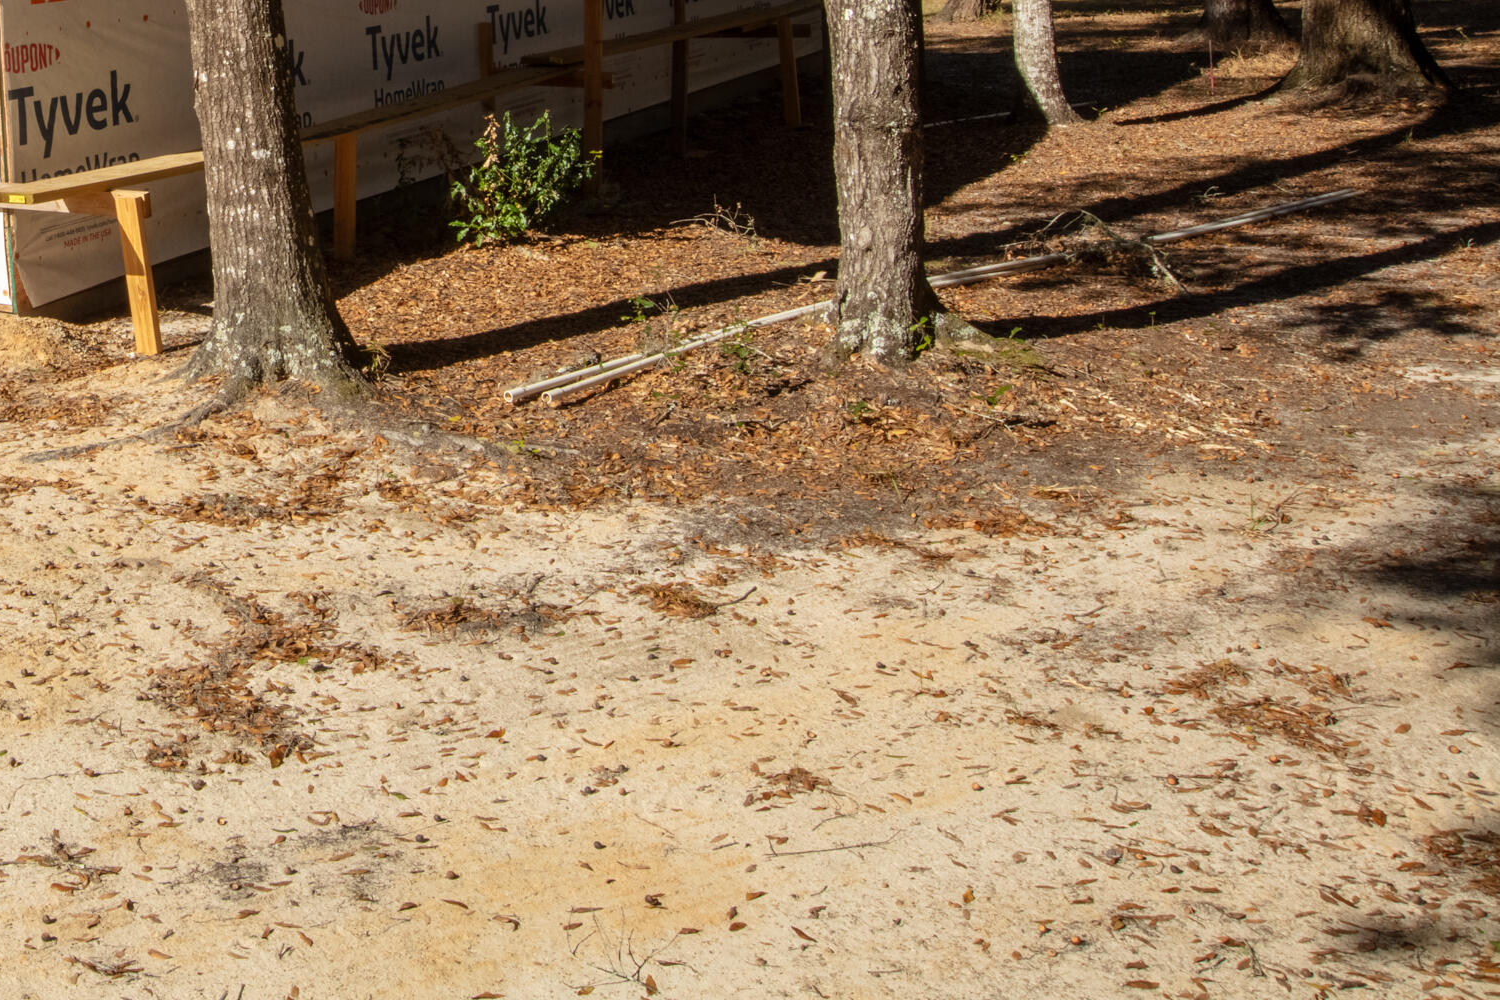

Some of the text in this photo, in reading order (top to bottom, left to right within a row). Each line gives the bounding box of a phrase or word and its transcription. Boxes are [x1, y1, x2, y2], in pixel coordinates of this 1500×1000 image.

[4, 43, 54, 74] DUPONT
[366, 15, 441, 81] Tyvek
[8, 69, 134, 159] Tyvek
